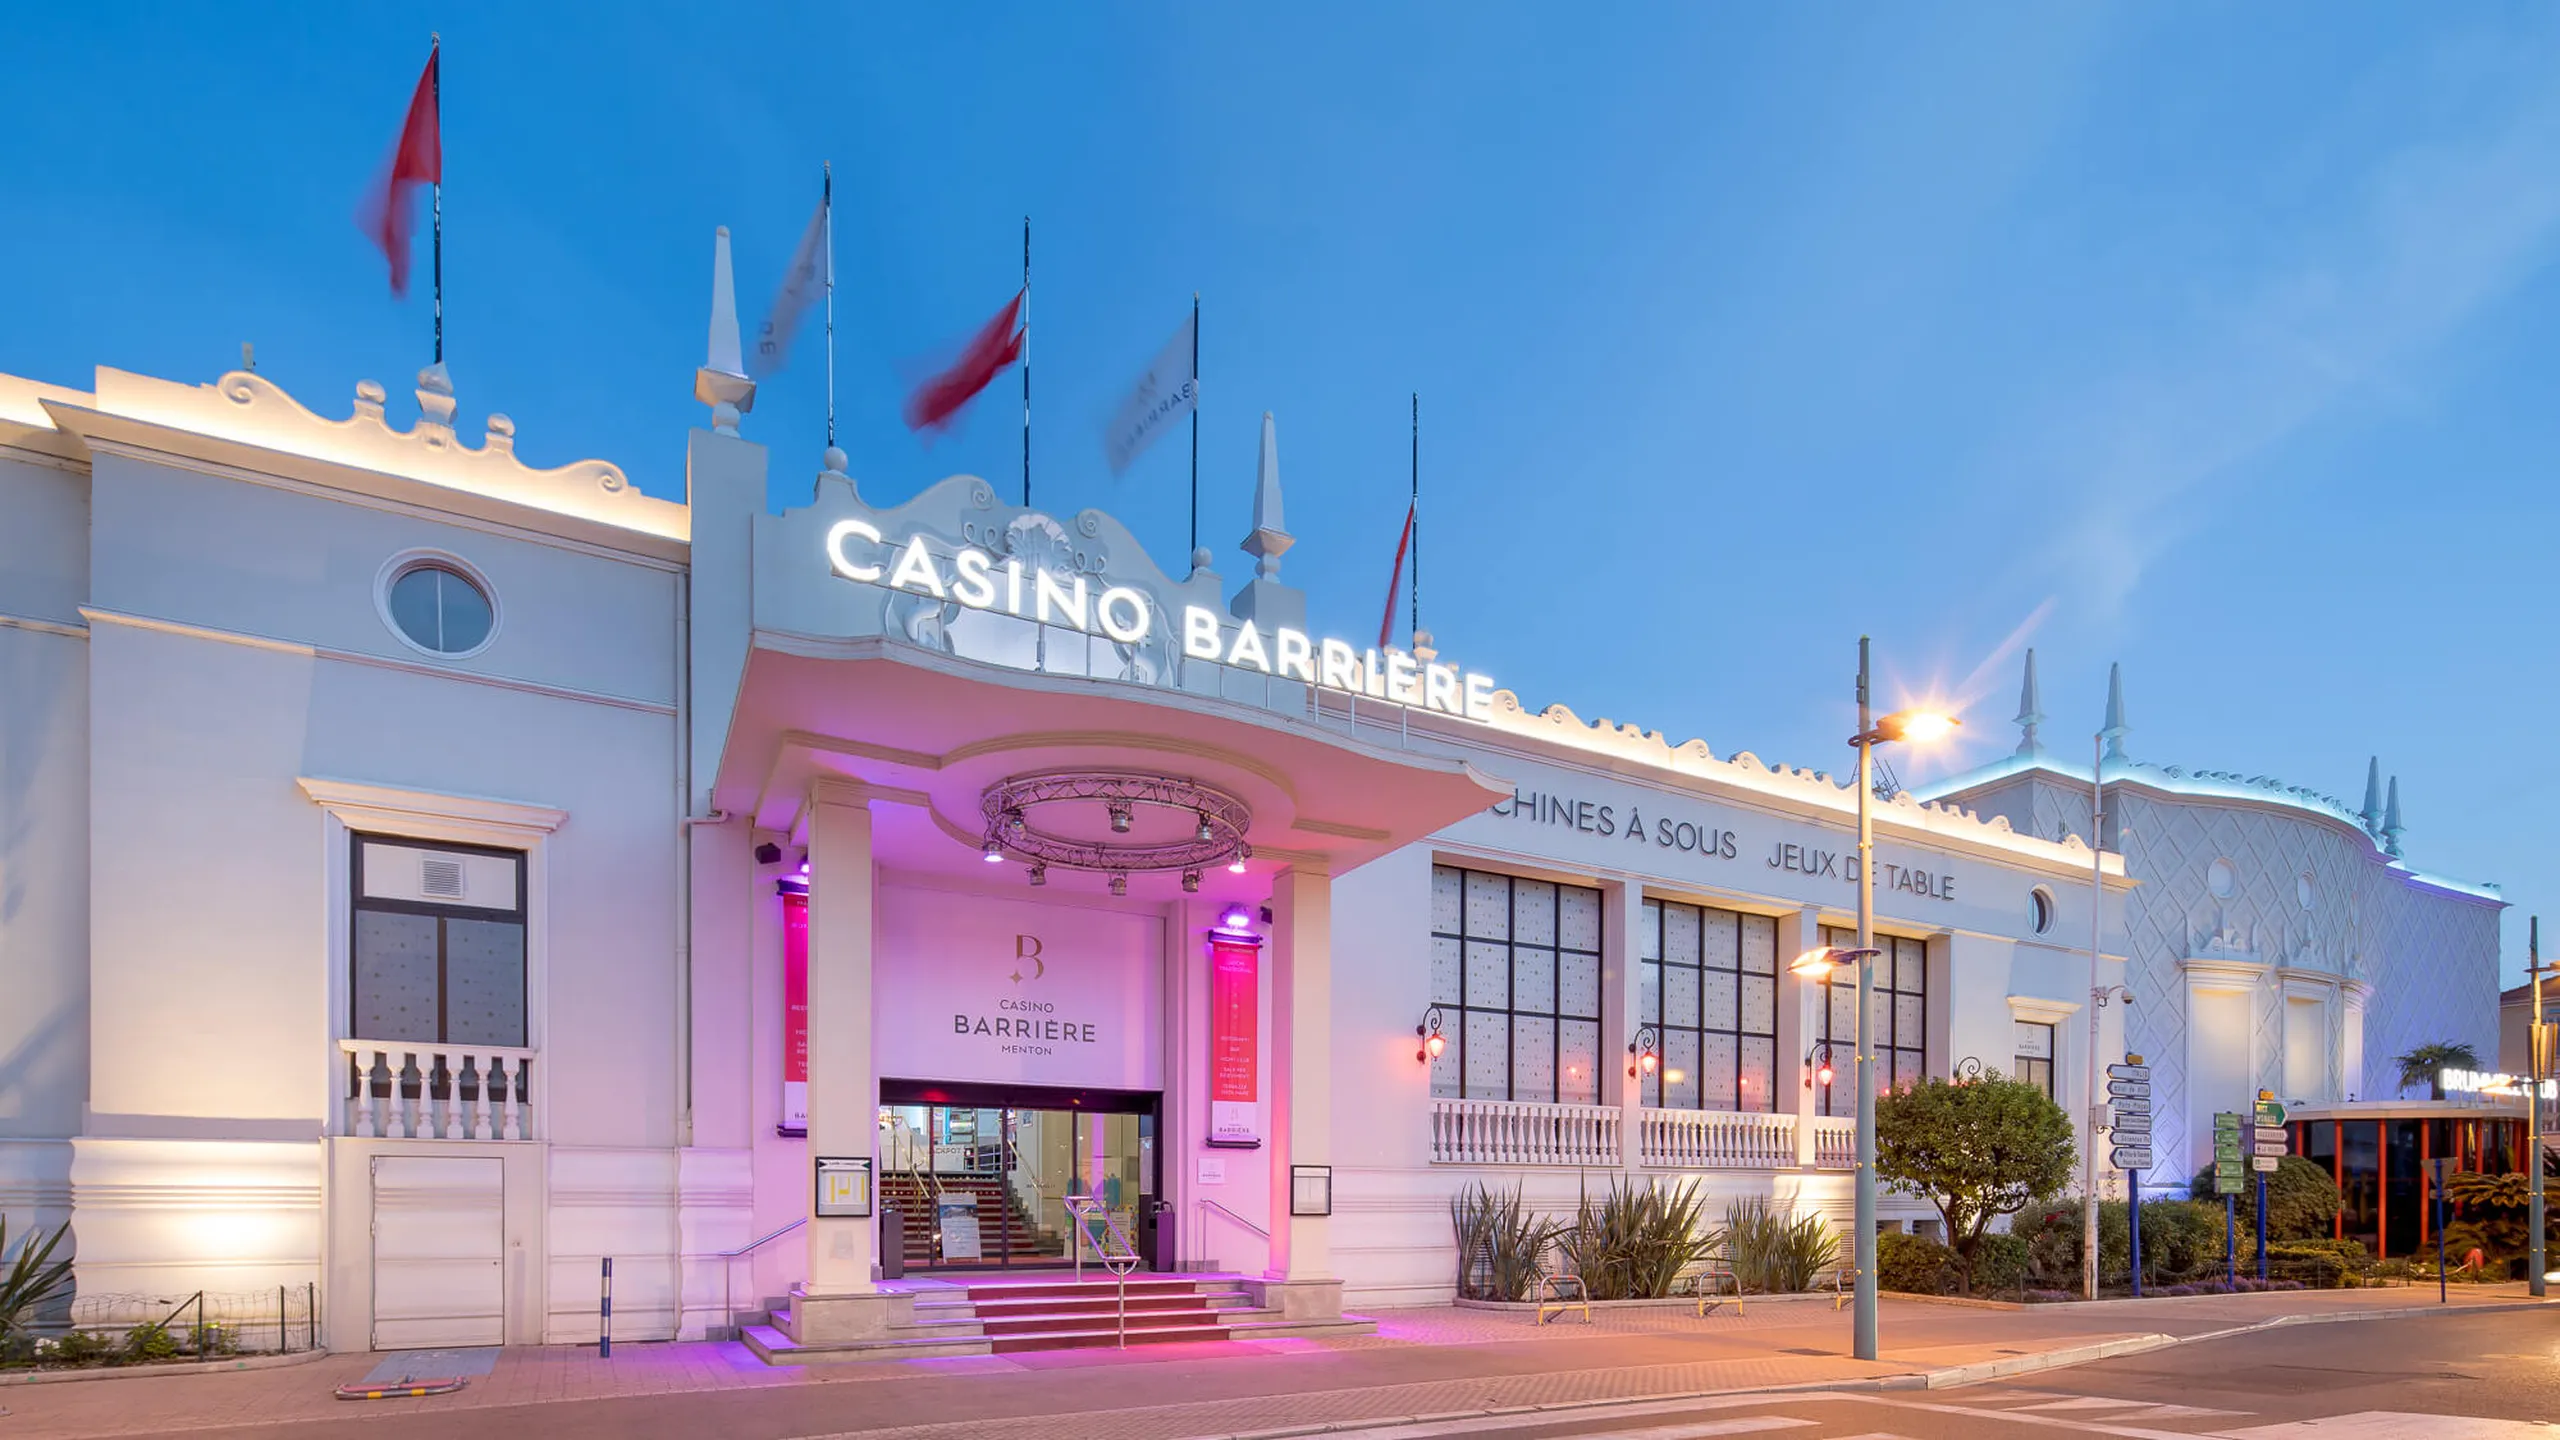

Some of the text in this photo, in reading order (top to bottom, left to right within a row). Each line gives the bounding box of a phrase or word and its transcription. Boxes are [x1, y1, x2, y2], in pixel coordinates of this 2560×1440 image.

[826, 519, 1150, 645] CASINO
[1624, 806, 1647, 842] À
[1658, 817, 1737, 860] SOUS
[1768, 842, 1837, 878] JEUX
[1883, 863, 1955, 901] TABLE
[999, 999, 1055, 1013] CASINO
[954, 1014, 1096, 1042] BARRIÈRE
[1001, 1045, 1052, 1055] MENTON
